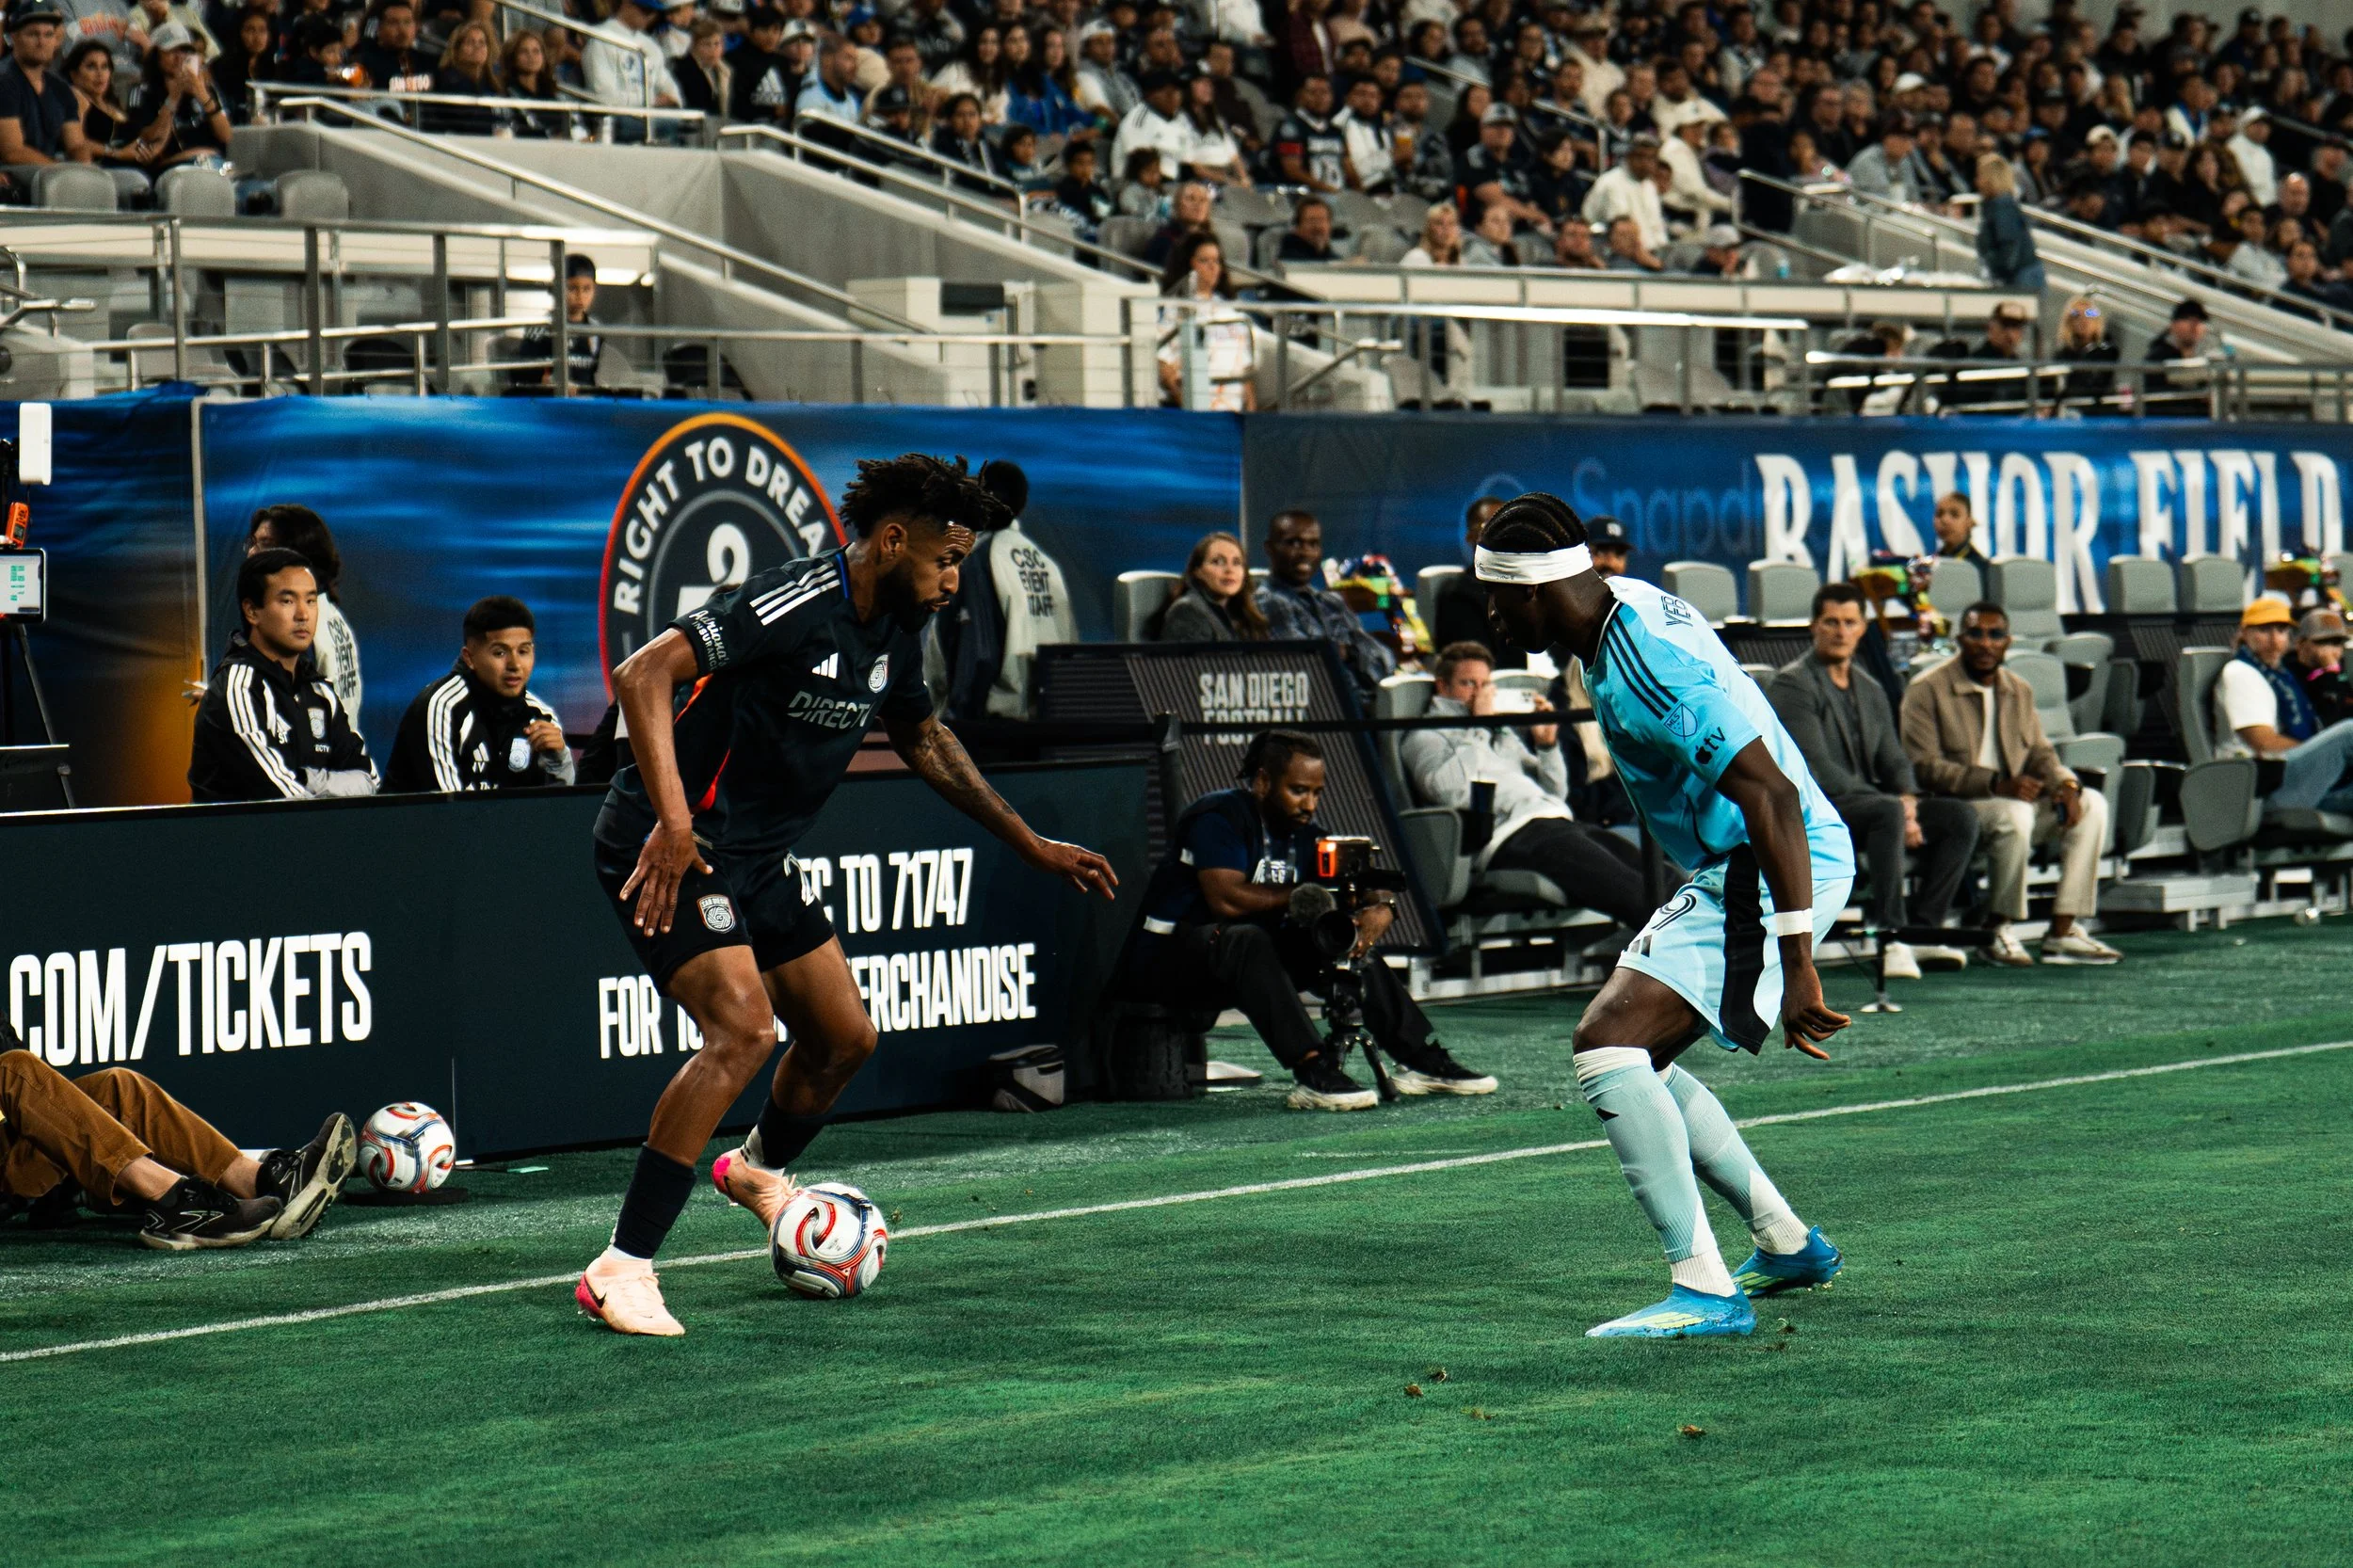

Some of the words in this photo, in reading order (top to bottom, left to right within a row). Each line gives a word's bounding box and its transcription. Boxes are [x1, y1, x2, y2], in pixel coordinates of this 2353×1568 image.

[614, 459, 680, 615] RIGHT
[684, 437, 734, 482] TO
[1011, 548, 1045, 568] CSC
[1200, 673, 1243, 708] SAN
[1247, 672, 1308, 708] DIEGO
[788, 690, 875, 729] DIRECT
[1667, 713, 1681, 728] MLS
[1705, 727, 1726, 750] tv
[840, 855, 882, 933] TO
[888, 848, 973, 930] 71747
[599, 975, 663, 1058] FOR
[846, 943, 1036, 1032] ERCHANDISE
